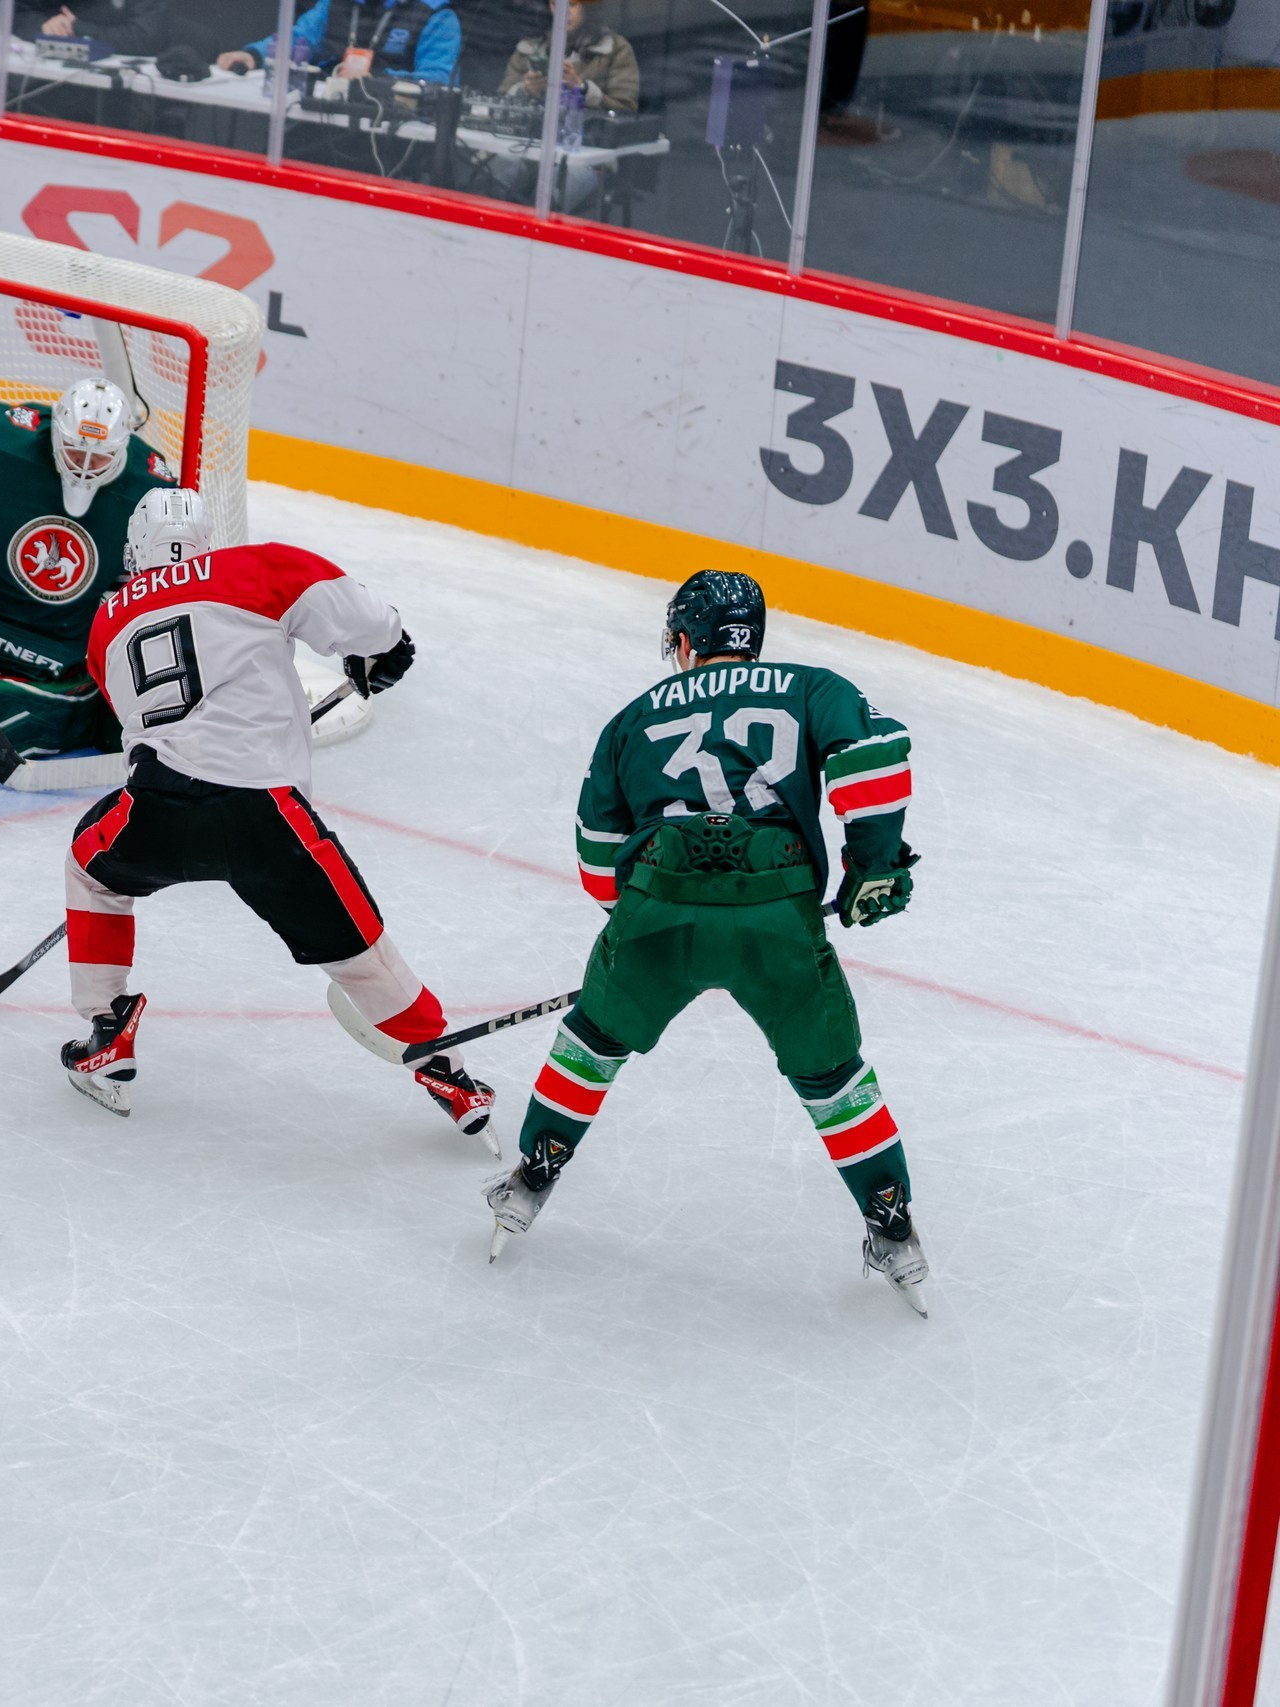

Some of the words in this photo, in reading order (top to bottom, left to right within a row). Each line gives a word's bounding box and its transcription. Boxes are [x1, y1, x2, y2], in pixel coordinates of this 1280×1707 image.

[170, 541, 182, 563] 9
[107, 555, 212, 619] FISKOV
[726, 627, 751, 649] 32
[125, 611, 205, 729] 9
[649, 666, 795, 710] YAKUPOV
[643, 707, 800, 818] 32
[125, 1000, 143, 1034] CCM
[488, 993, 569, 1033] CCM
[74, 1047, 118, 1073] CCM
[420, 1076, 455, 1094] CCM
